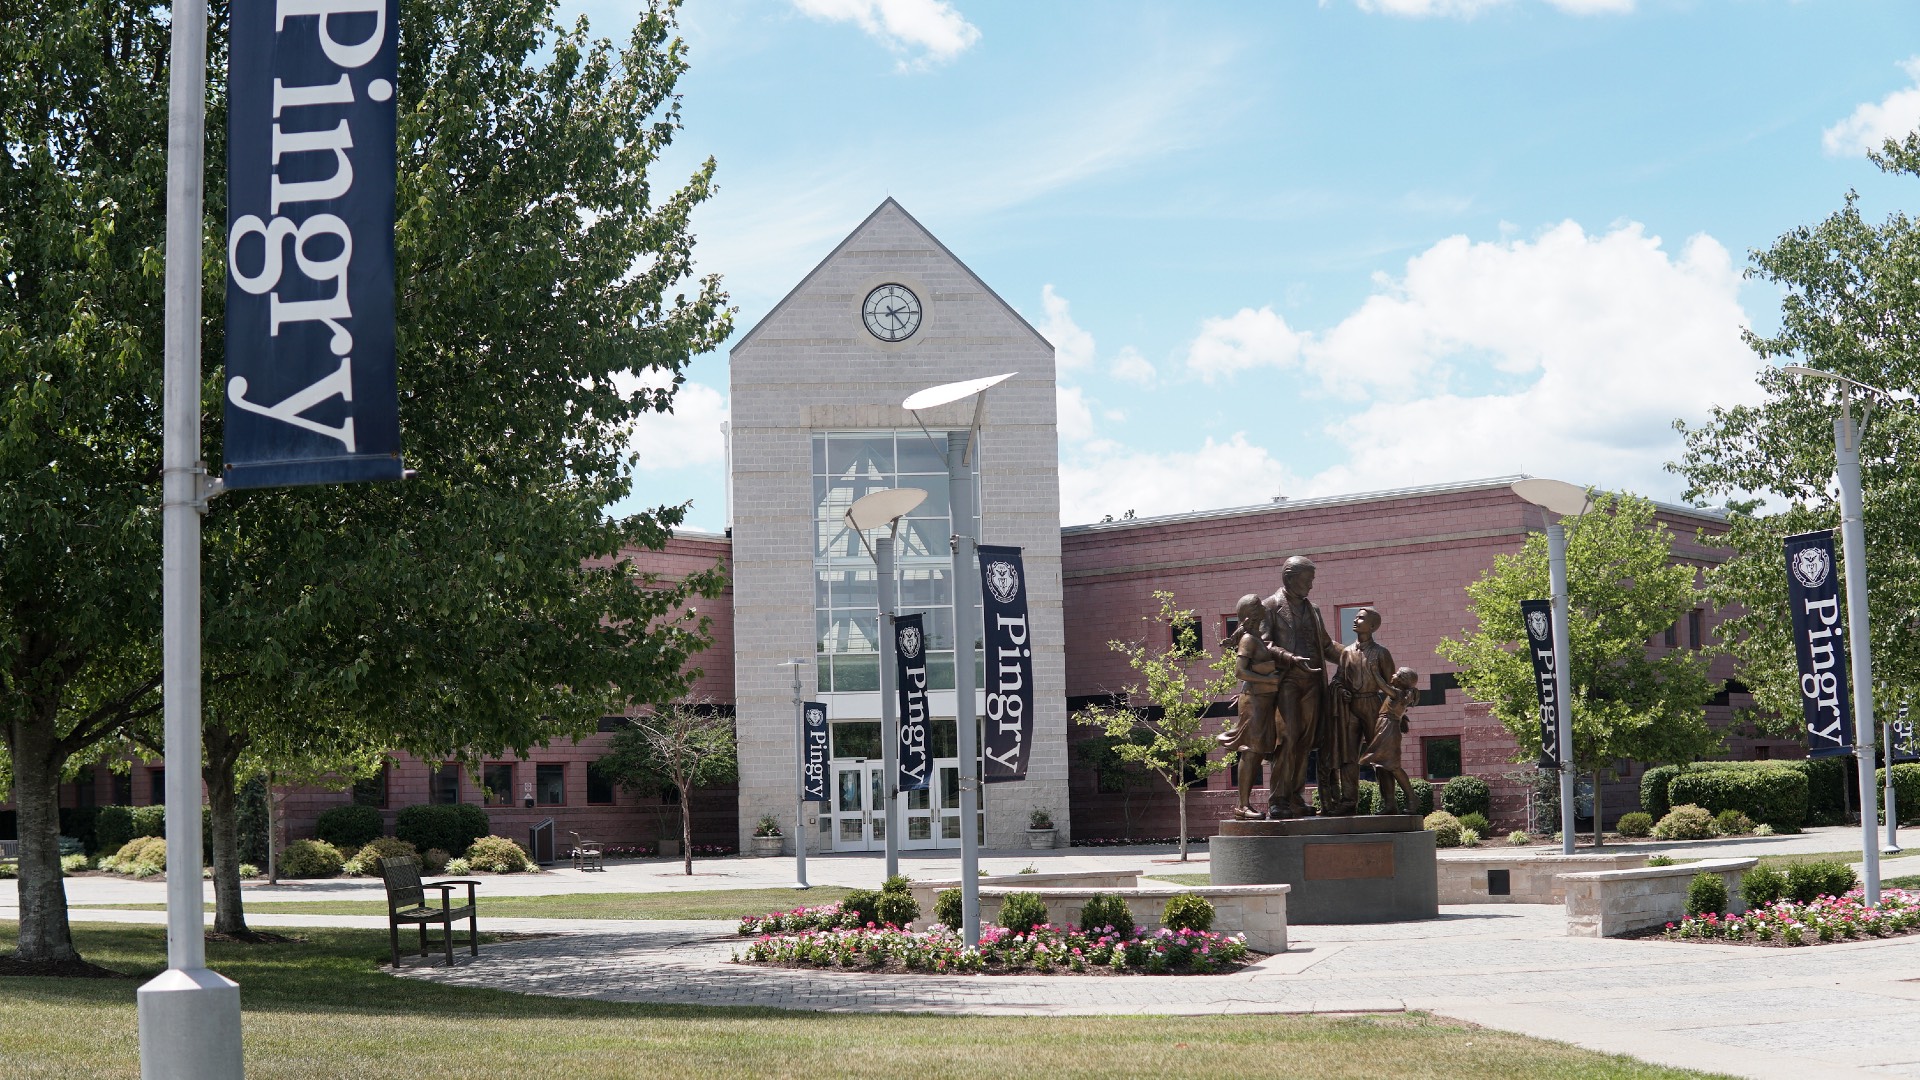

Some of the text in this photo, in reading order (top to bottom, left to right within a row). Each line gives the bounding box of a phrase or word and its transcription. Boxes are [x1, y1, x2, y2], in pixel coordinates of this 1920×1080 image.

[227, 0, 393, 453] Pingry
[901, 664, 929, 784] Pingry
[985, 612, 1031, 774] Pingry
[1537, 647, 1557, 762] Pingry
[1801, 594, 1843, 747] Pingry
[805, 730, 828, 798] Pingry
